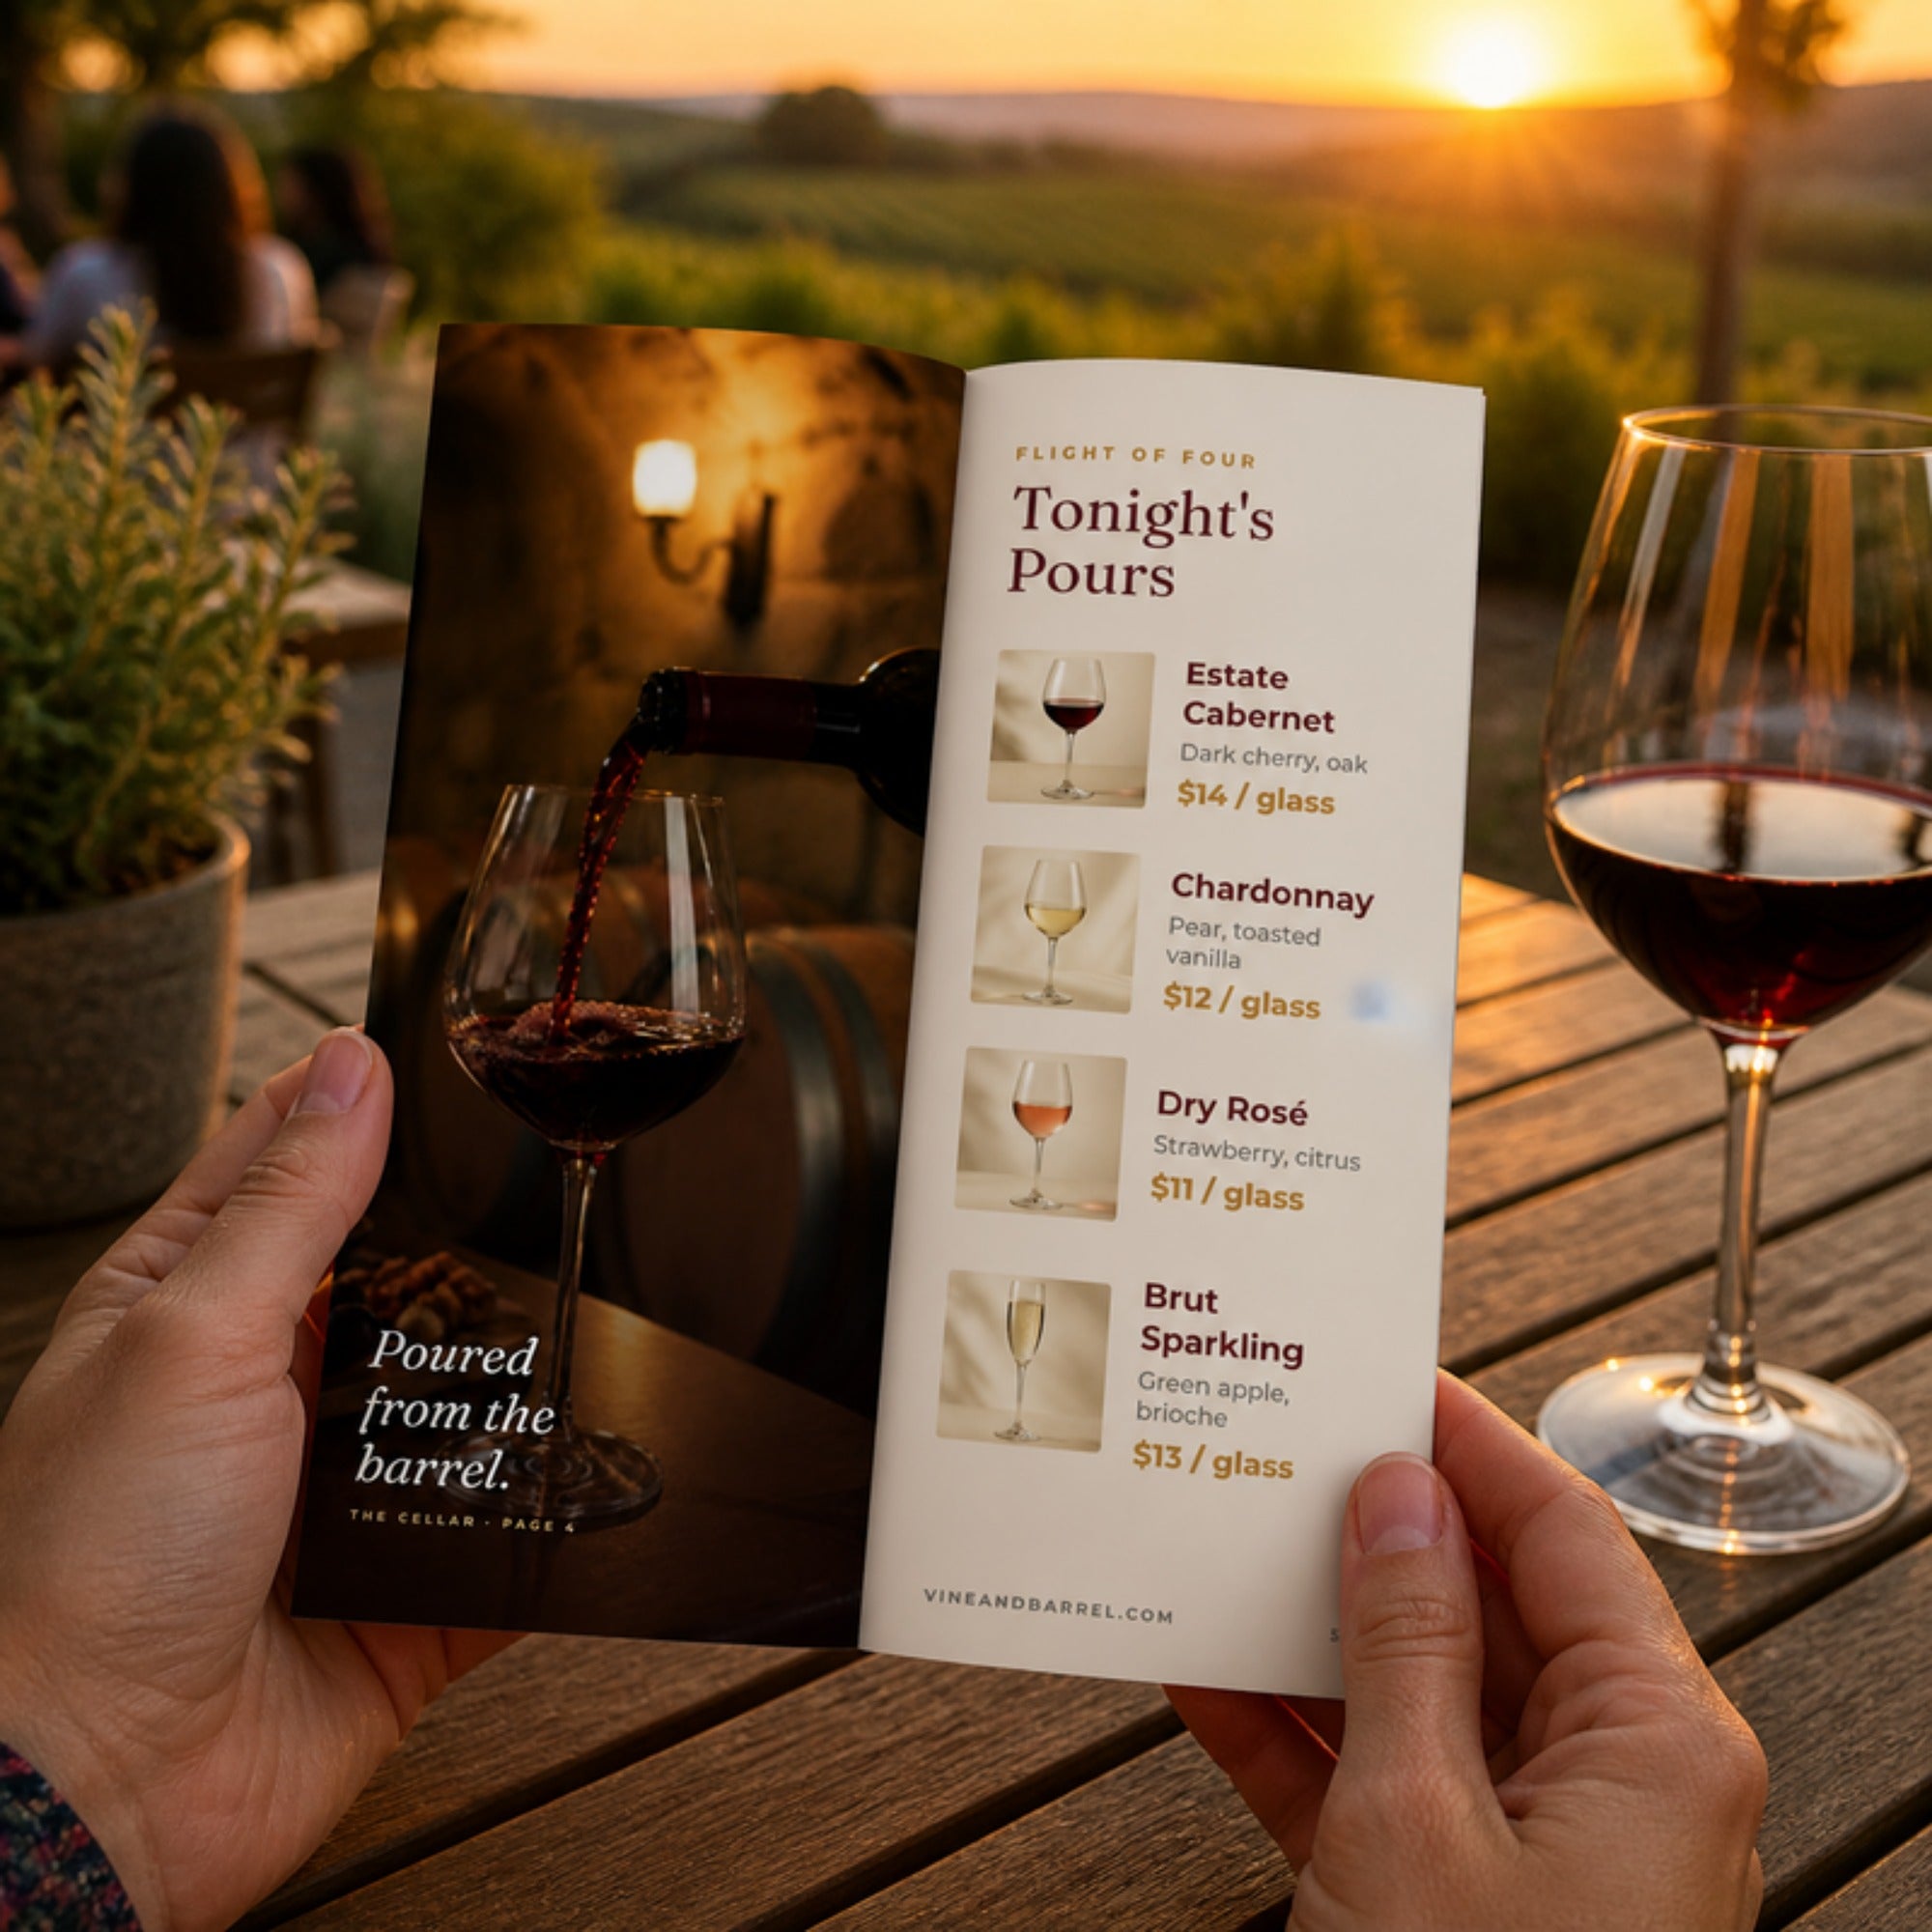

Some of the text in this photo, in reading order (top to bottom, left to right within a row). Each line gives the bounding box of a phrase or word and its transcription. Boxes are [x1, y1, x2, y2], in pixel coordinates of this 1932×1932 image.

[1015, 445, 1256, 469] FLIGHT OF FOUR
[1012, 485, 1276, 550] Tonight's
[1007, 547, 1176, 598] Pours
[1185, 662, 1290, 690] Estate
[1182, 701, 1336, 734] Cabernet
[1180, 742, 1369, 775] Dark cherry, oak
[1177, 779, 1335, 815] $14 / glass
[1171, 872, 1376, 920] Chardonnay
[1168, 916, 1322, 948] Pear, toasted
[1165, 948, 1242, 970] vanilla
[1163, 981, 1321, 1020] $12 / glass
[1157, 1090, 1309, 1126] Dry Rosé
[1153, 1134, 1362, 1173] Strawberry, citrus
[1150, 1173, 1305, 1212] $11 / glass
[1143, 1281, 1219, 1314] Brut
[367, 1328, 540, 1377] Poured
[1140, 1324, 1305, 1371] Sparkling
[1137, 1371, 1290, 1406] Green apple,
[357, 1385, 555, 1436] from the
[1135, 1400, 1228, 1428] brioche
[355, 1441, 509, 1492] barrel.
[1132, 1439, 1294, 1481] $13 / glass
[349, 1508, 386, 1523] THE
[397, 1511, 475, 1527] CELLAR
[501, 1517, 554, 1533] PAGE
[923, 1587, 1174, 1625] VINEANDBARREL.COM
